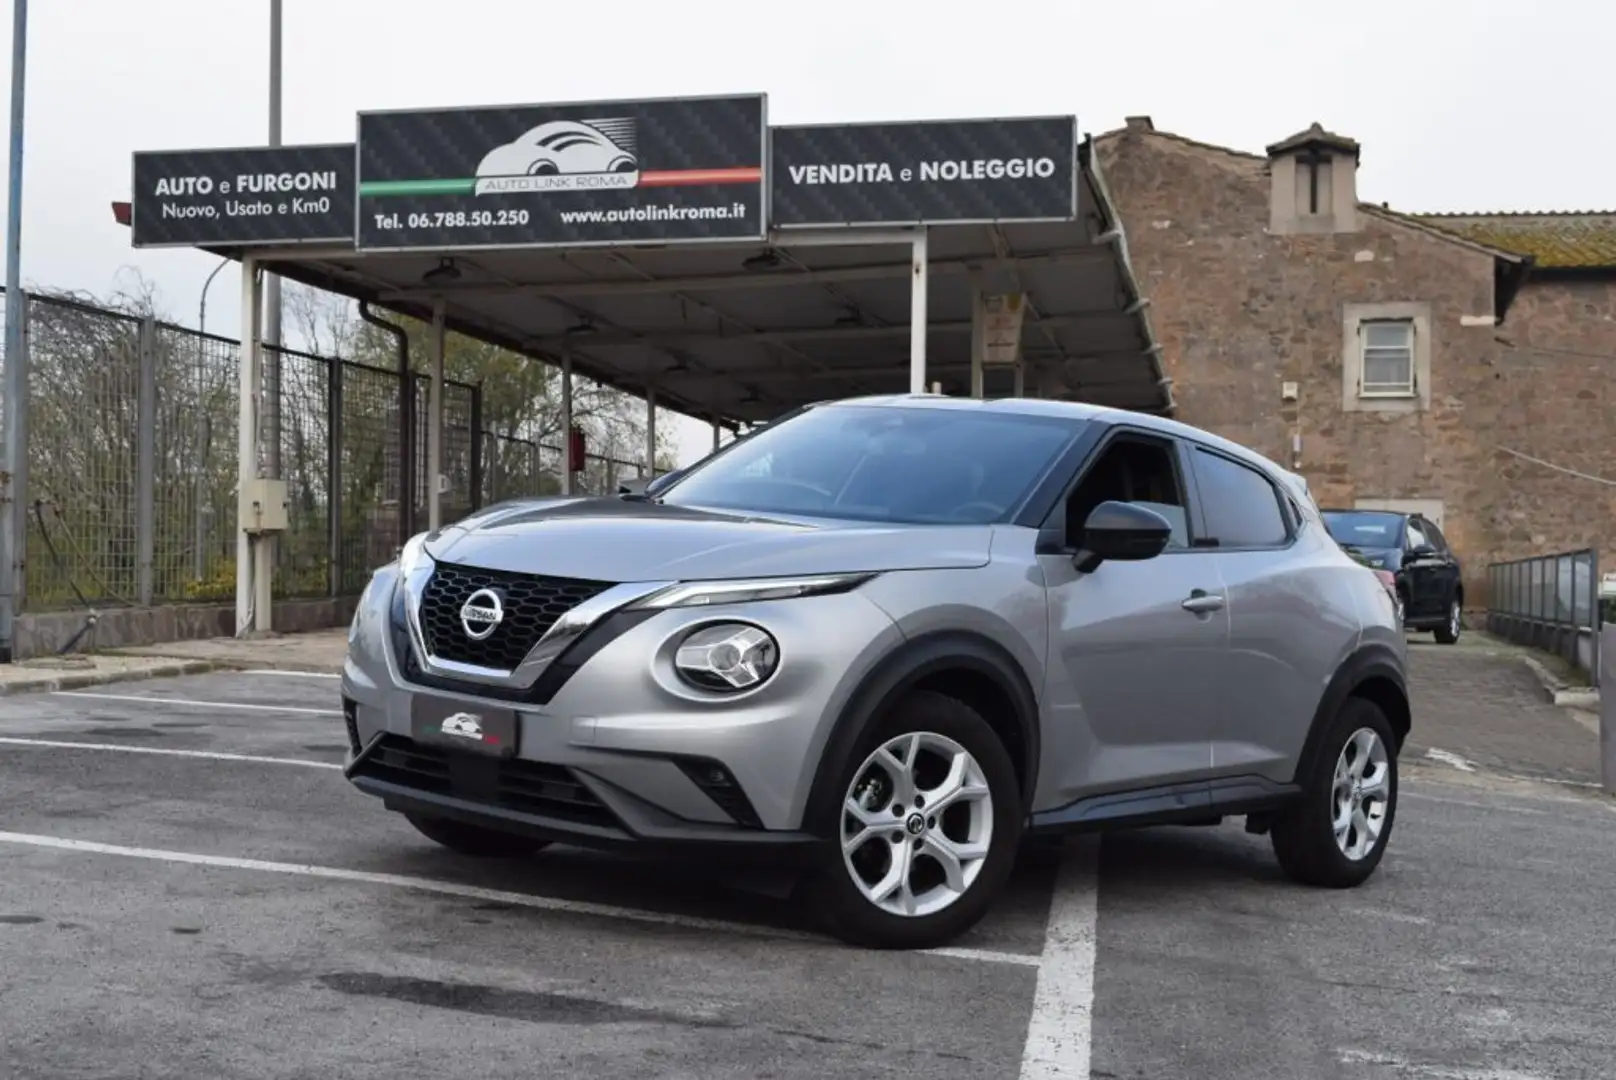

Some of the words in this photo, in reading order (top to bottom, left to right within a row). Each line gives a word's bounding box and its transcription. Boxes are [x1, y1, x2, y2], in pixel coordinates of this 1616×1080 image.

[788, 163, 893, 184] VENDITA
[900, 167, 912, 181] e
[919, 158, 1055, 182] NOLEGGIO
[155, 177, 213, 196] AUTO
[219, 179, 231, 193] e
[236, 172, 336, 193] FURGONI
[485, 179, 529, 190] AUTO
[534, 178, 571, 188] LINK
[575, 176, 628, 187] ROMA
[162, 202, 221, 220] Nuovo,
[225, 200, 273, 217] Usato
[278, 204, 288, 215] e
[292, 196, 330, 214] Km0
[374, 213, 403, 229] Tel.
[408, 209, 529, 229] 06.788.50.250
[560, 202, 746, 224] www.autolinkroma.it
